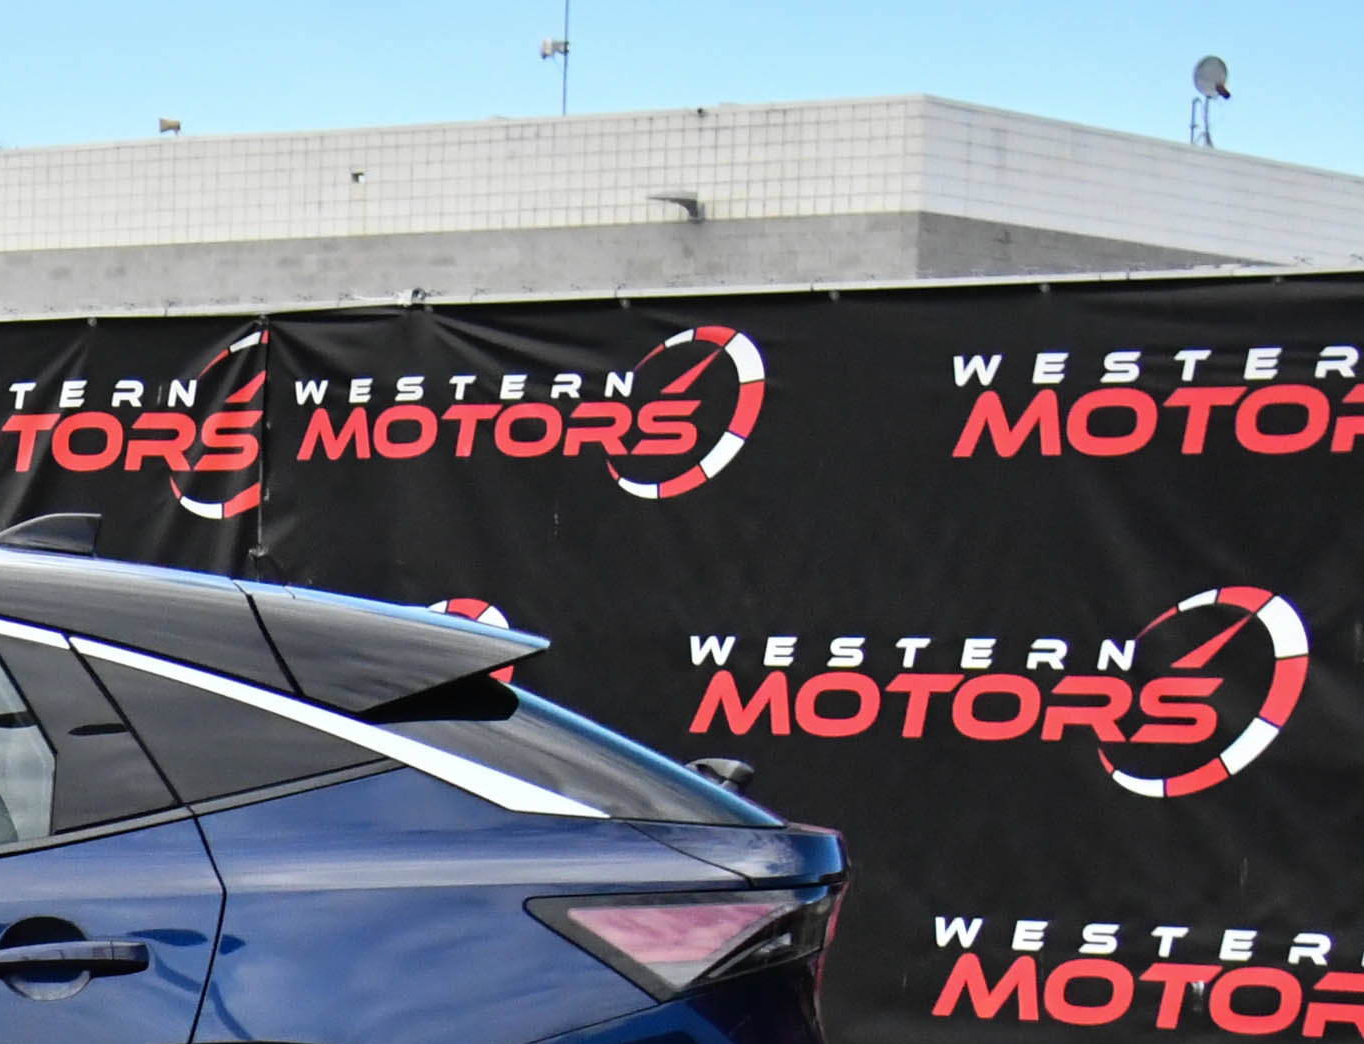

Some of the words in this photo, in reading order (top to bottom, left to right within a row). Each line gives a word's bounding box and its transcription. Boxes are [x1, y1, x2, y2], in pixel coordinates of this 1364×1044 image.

[294, 371, 634, 406] WESTERN
[954, 346, 1359, 387] WESTER
[296, 399, 702, 462] MOTORS
[690, 635, 1136, 671] WESTERN
[688, 669, 1224, 745] MOTORS
[935, 916, 1364, 967] WESTER
